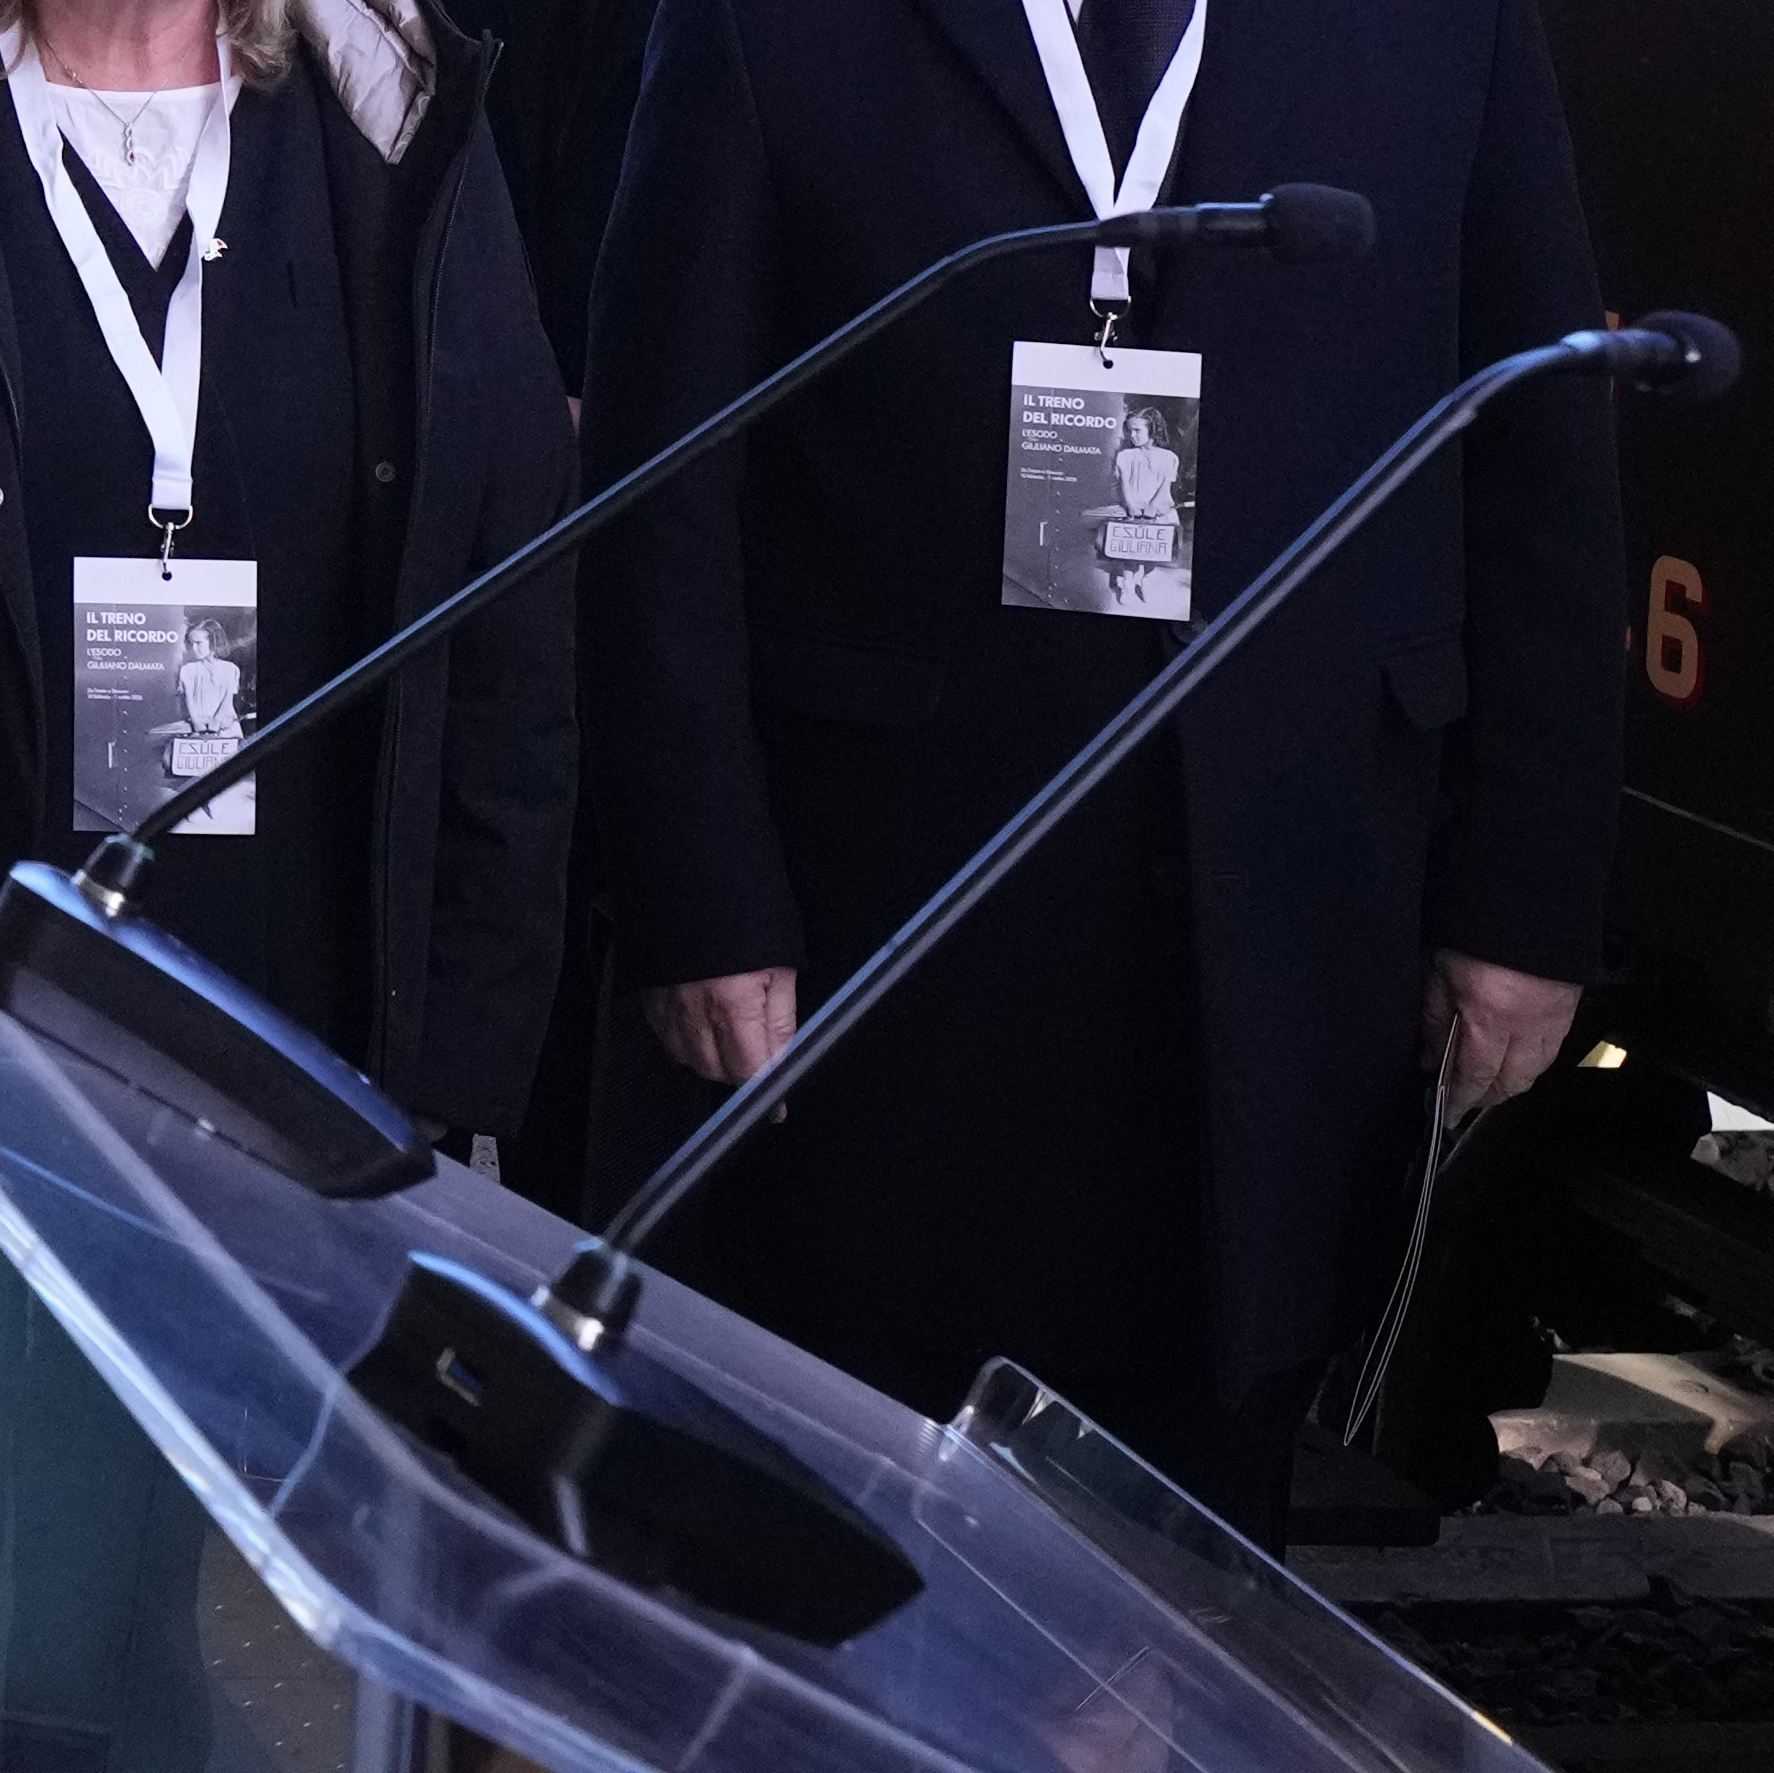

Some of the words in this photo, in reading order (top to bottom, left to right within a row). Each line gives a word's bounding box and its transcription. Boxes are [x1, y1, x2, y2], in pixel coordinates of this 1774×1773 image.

[1024, 394, 1037, 407] IL
[1037, 395, 1085, 410] TRENO
[1023, 411, 1049, 425] DEL
[1050, 412, 1118, 430] RICORDO
[86, 611, 99, 625] IL
[99, 611, 147, 626] TRENO
[86, 628, 112, 642] DEL
[113, 629, 180, 644] RICORDO
